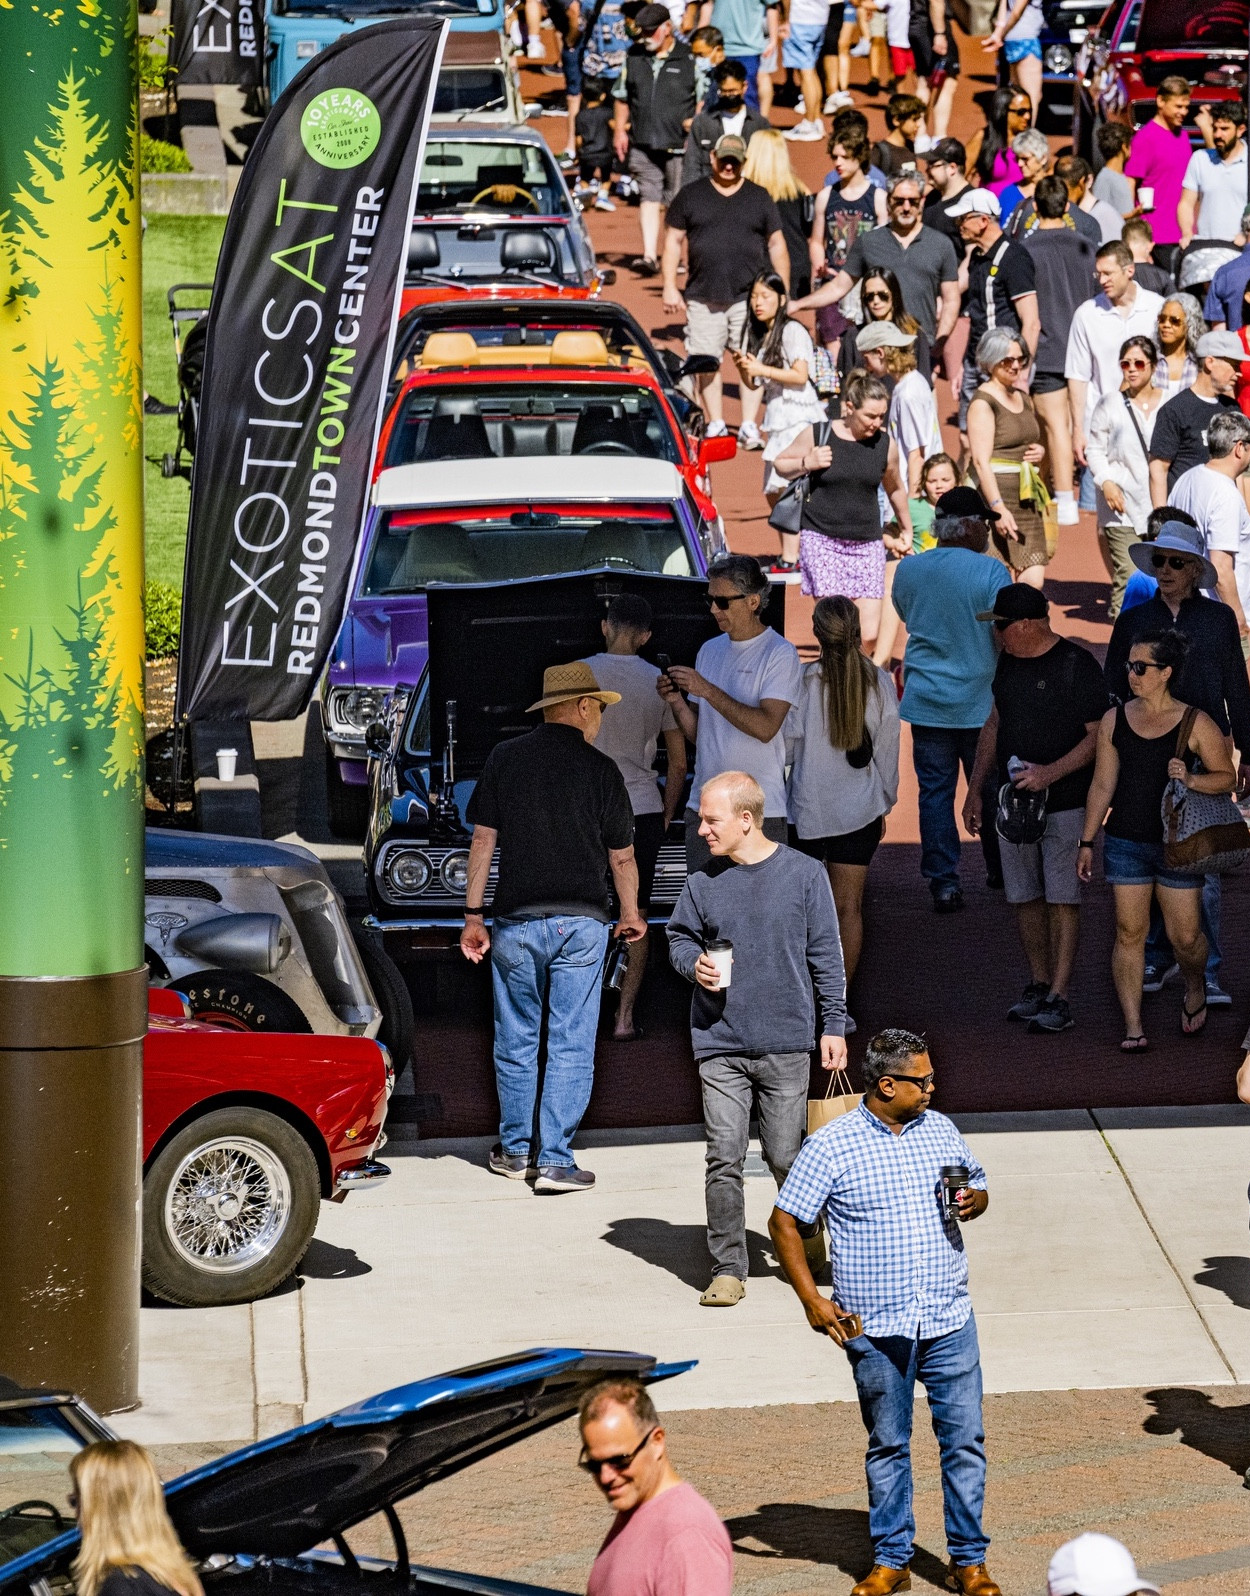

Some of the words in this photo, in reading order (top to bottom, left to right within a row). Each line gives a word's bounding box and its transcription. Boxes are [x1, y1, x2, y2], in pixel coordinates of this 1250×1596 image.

[313, 126, 369, 141] ESTABLISHED
[315, 134, 370, 160] ANNIVERSARY
[189, 988, 265, 1024] estone
